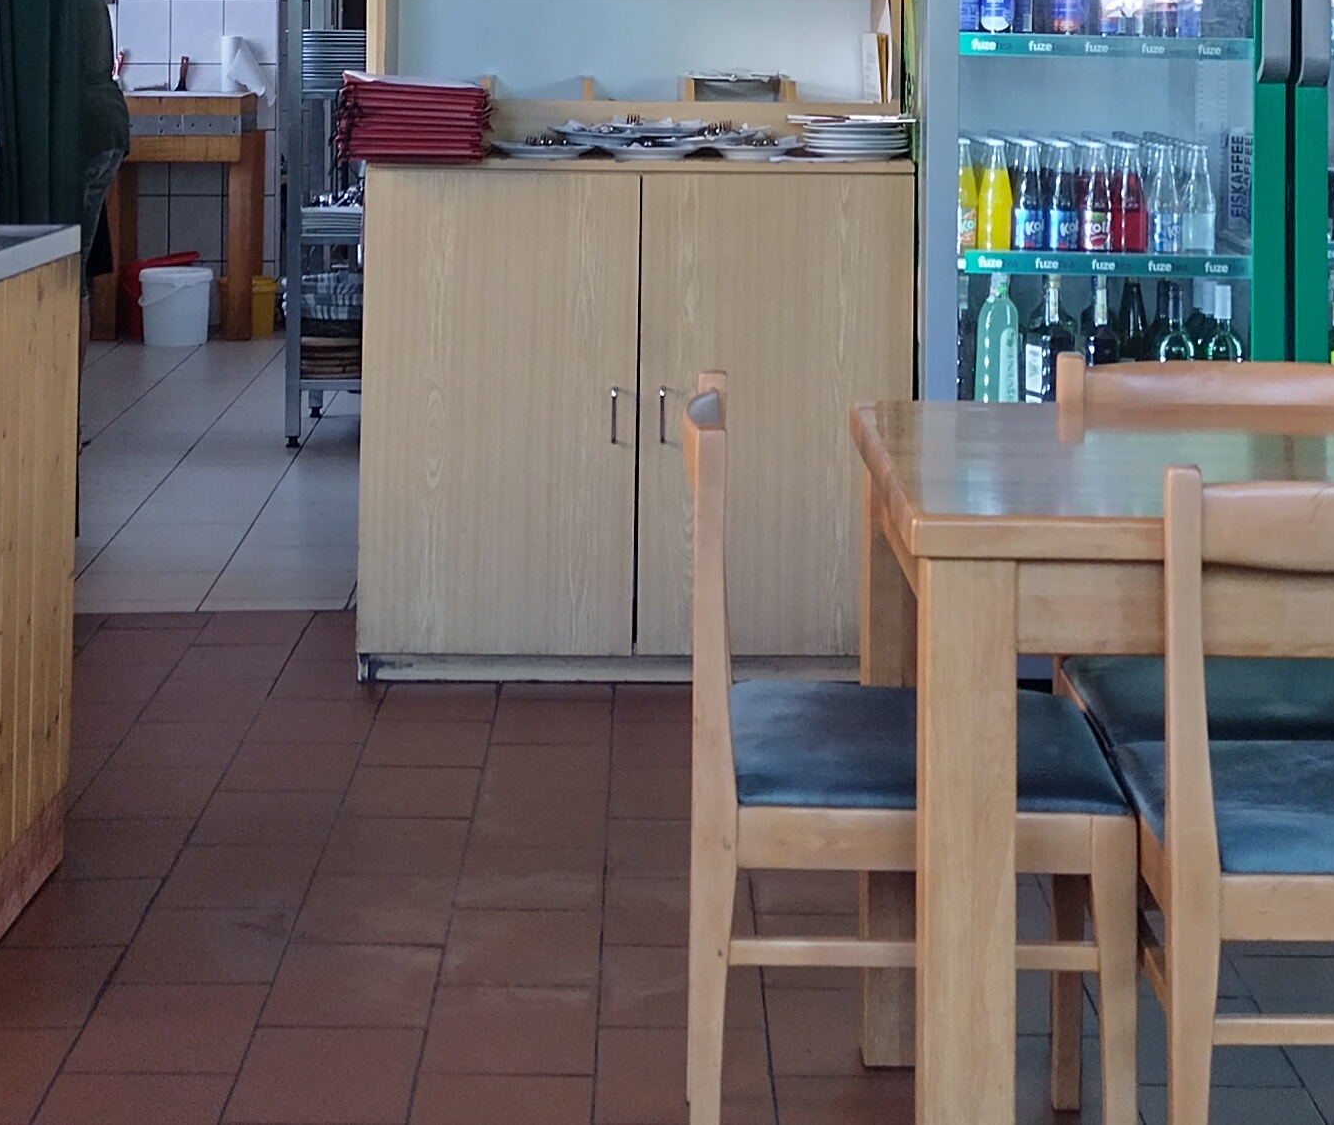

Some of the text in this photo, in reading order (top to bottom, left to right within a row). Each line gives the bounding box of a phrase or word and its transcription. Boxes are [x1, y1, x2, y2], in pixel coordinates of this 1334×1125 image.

[971, 38, 997, 51] fuze
[1028, 40, 1053, 52] fuze
[1085, 41, 1109, 53] fuze
[1141, 43, 1165, 55] fuze
[1198, 44, 1222, 56] fuze
[1231, 135, 1244, 218] EISKAFFEE
[978, 256, 1003, 269] fuze
[1035, 257, 1059, 270] fuze
[1091, 258, 1116, 271] fuze
[1148, 259, 1172, 272] fuze
[1204, 260, 1229, 273] fuze
